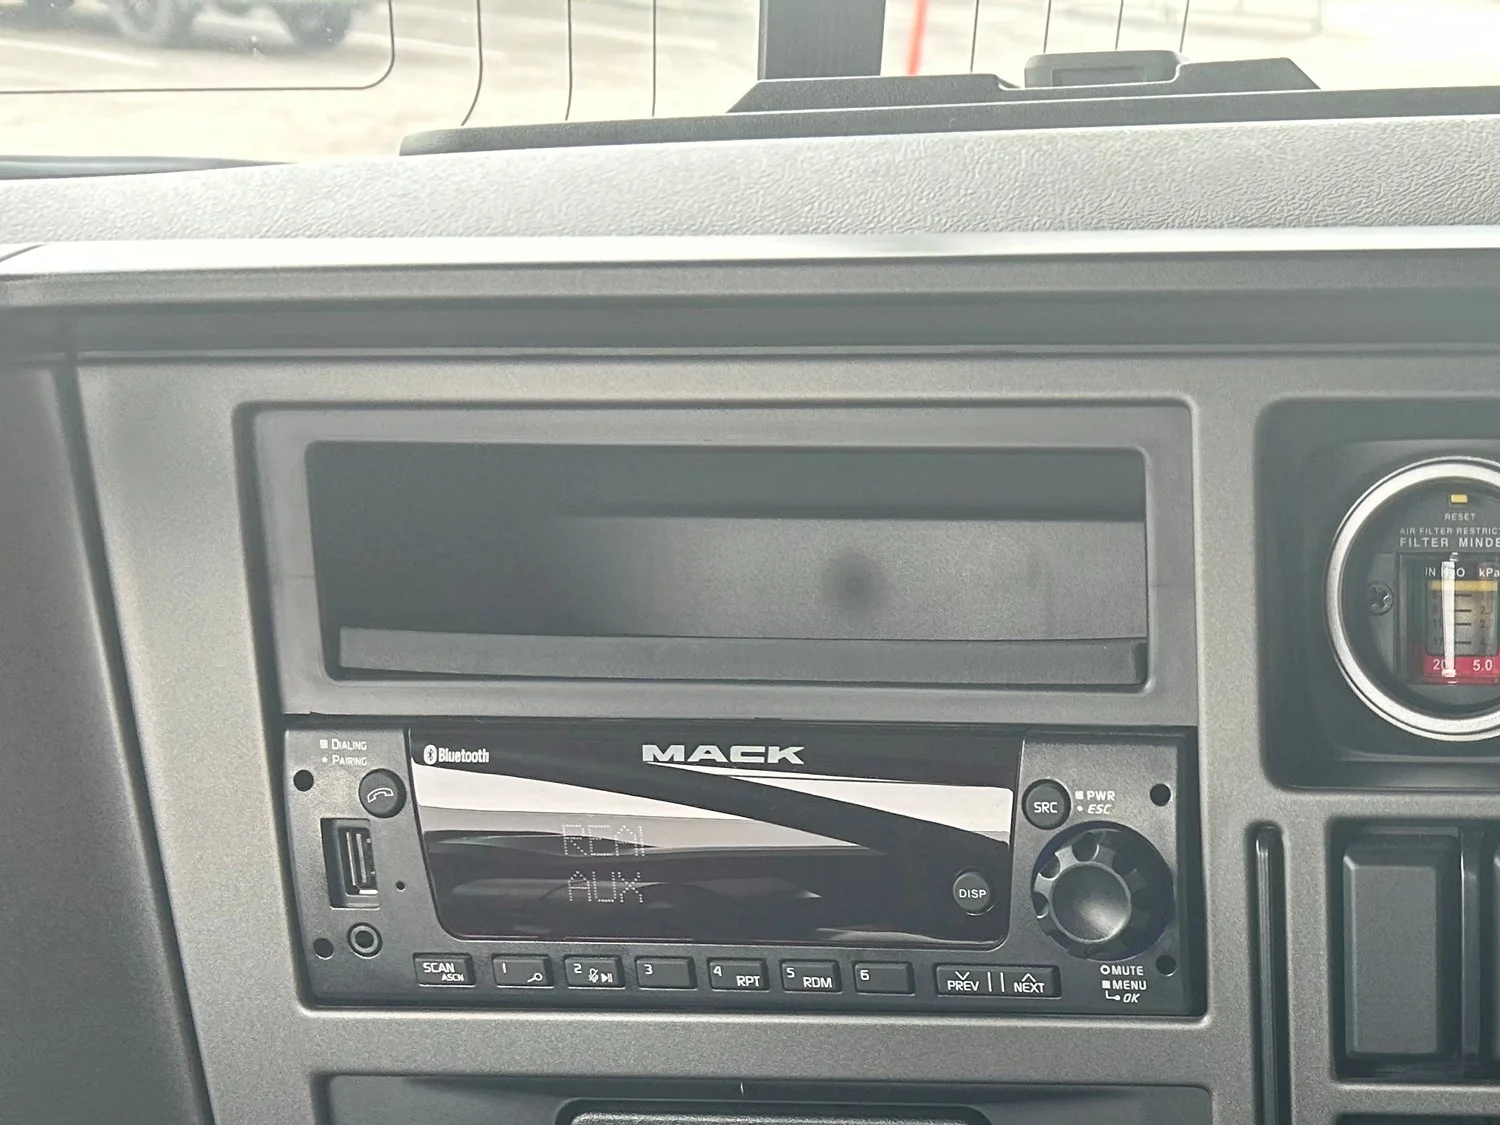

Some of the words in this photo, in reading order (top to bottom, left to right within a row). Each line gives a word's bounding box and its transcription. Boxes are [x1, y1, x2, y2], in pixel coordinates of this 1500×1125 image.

[1444, 513, 1475, 521] RESET
[1400, 538, 1449, 548] FILTER
[1425, 567, 1436, 576] IN
[1479, 568, 1500, 578] kPa
[1473, 660, 1492, 671] 5.0
[438, 748, 489, 763] Bluetooth
[642, 745, 804, 764] MACK
[1087, 791, 1115, 801] PWR
[1033, 802, 1058, 813] SRC
[1087, 805, 1111, 814] ESC
[568, 871, 643, 903] AUX
[958, 888, 986, 898] DISP
[423, 962, 455, 973] SCAN
[502, 963, 506, 973] 1
[574, 963, 582, 973] 2
[644, 964, 652, 974] 3
[713, 966, 722, 976] 4
[1111, 965, 1144, 976] MUTE
[442, 973, 464, 982] ASCN
[786, 968, 795, 978] 5
[860, 970, 869, 981] 6
[736, 976, 760, 986] RPT
[803, 977, 832, 988] RDM
[947, 980, 979, 991] PREV
[1112, 980, 1146, 990] MENU
[1013, 982, 1045, 993] NEXT
[1123, 993, 1139, 1003] OK
